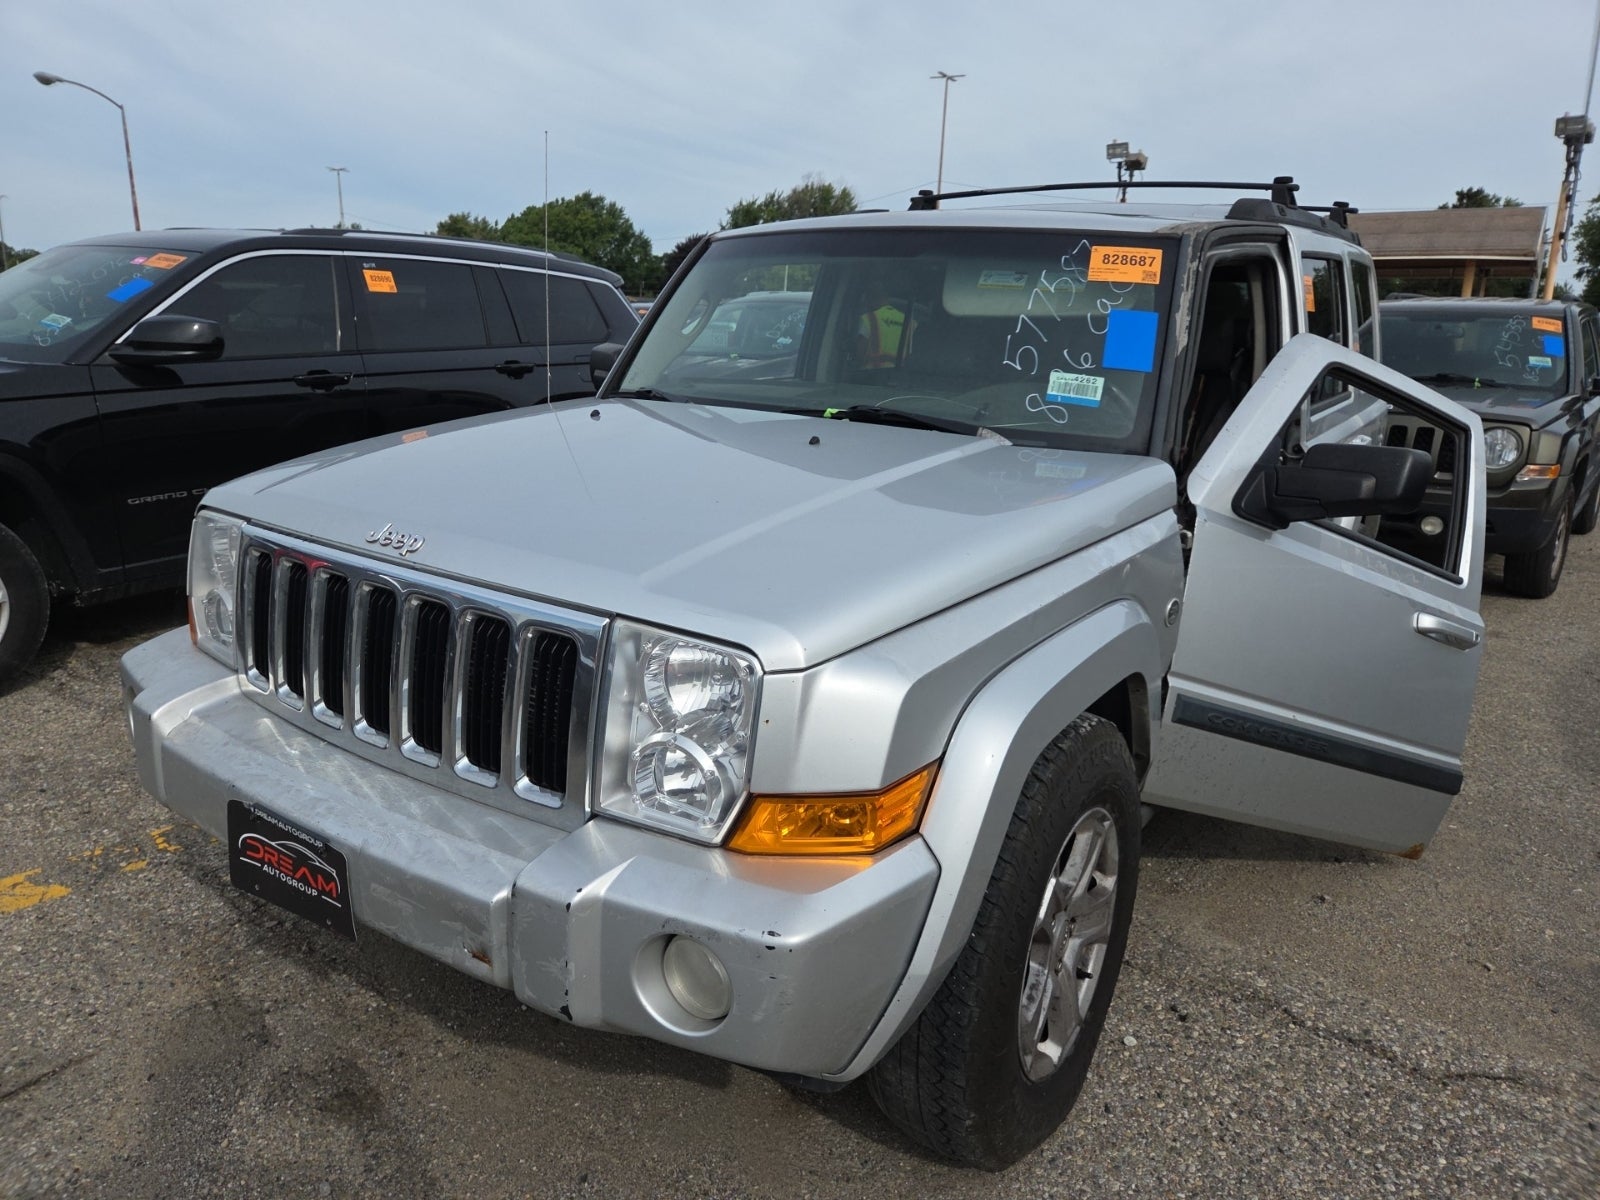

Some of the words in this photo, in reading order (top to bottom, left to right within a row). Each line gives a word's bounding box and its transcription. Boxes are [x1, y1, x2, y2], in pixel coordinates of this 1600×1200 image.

[1102, 253, 1156, 267] 828687
[127, 491, 188, 504] GRAND
[365, 523, 425, 556] Jeep
[246, 838, 337, 898] DREAM
[262, 864, 318, 897] AUTOGROUP
